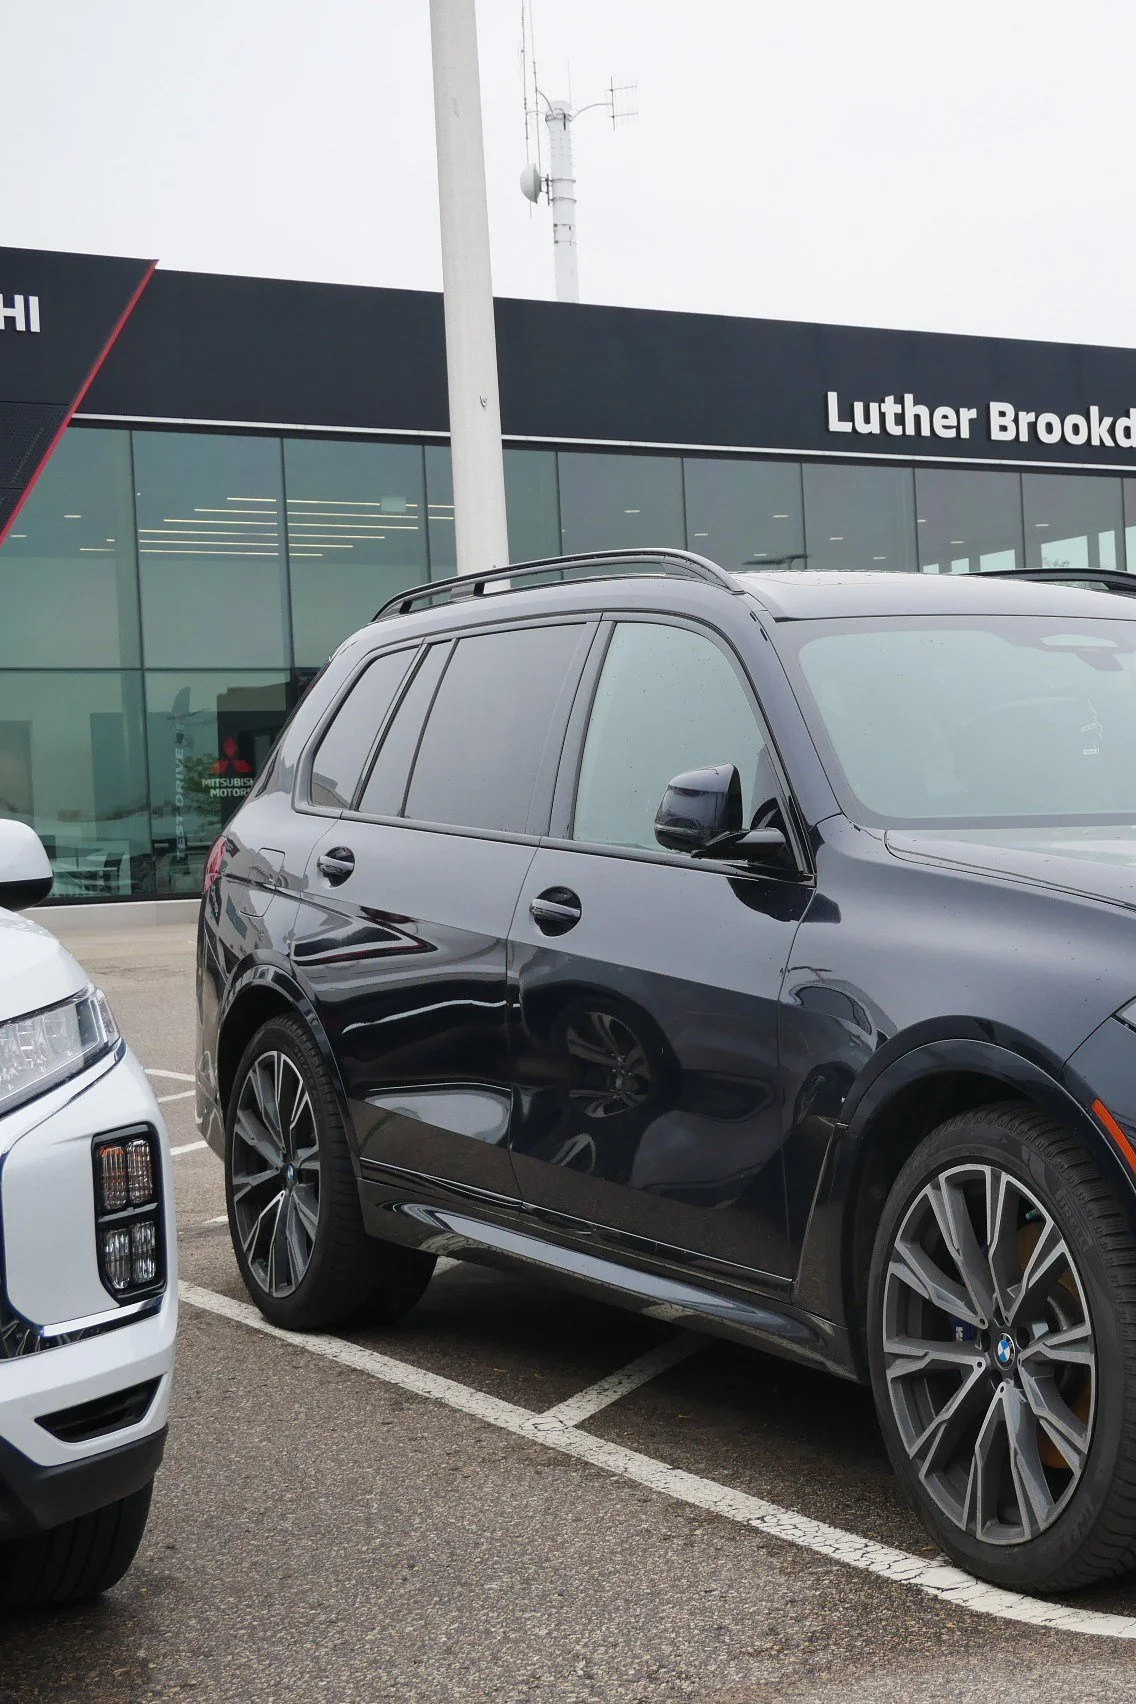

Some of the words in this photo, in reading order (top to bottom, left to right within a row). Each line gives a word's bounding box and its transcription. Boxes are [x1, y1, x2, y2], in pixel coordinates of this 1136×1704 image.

[827, 391, 977, 439] Luther
[175, 747, 184, 807] DRIVE
[201, 777, 255, 787] MITSUBISH
